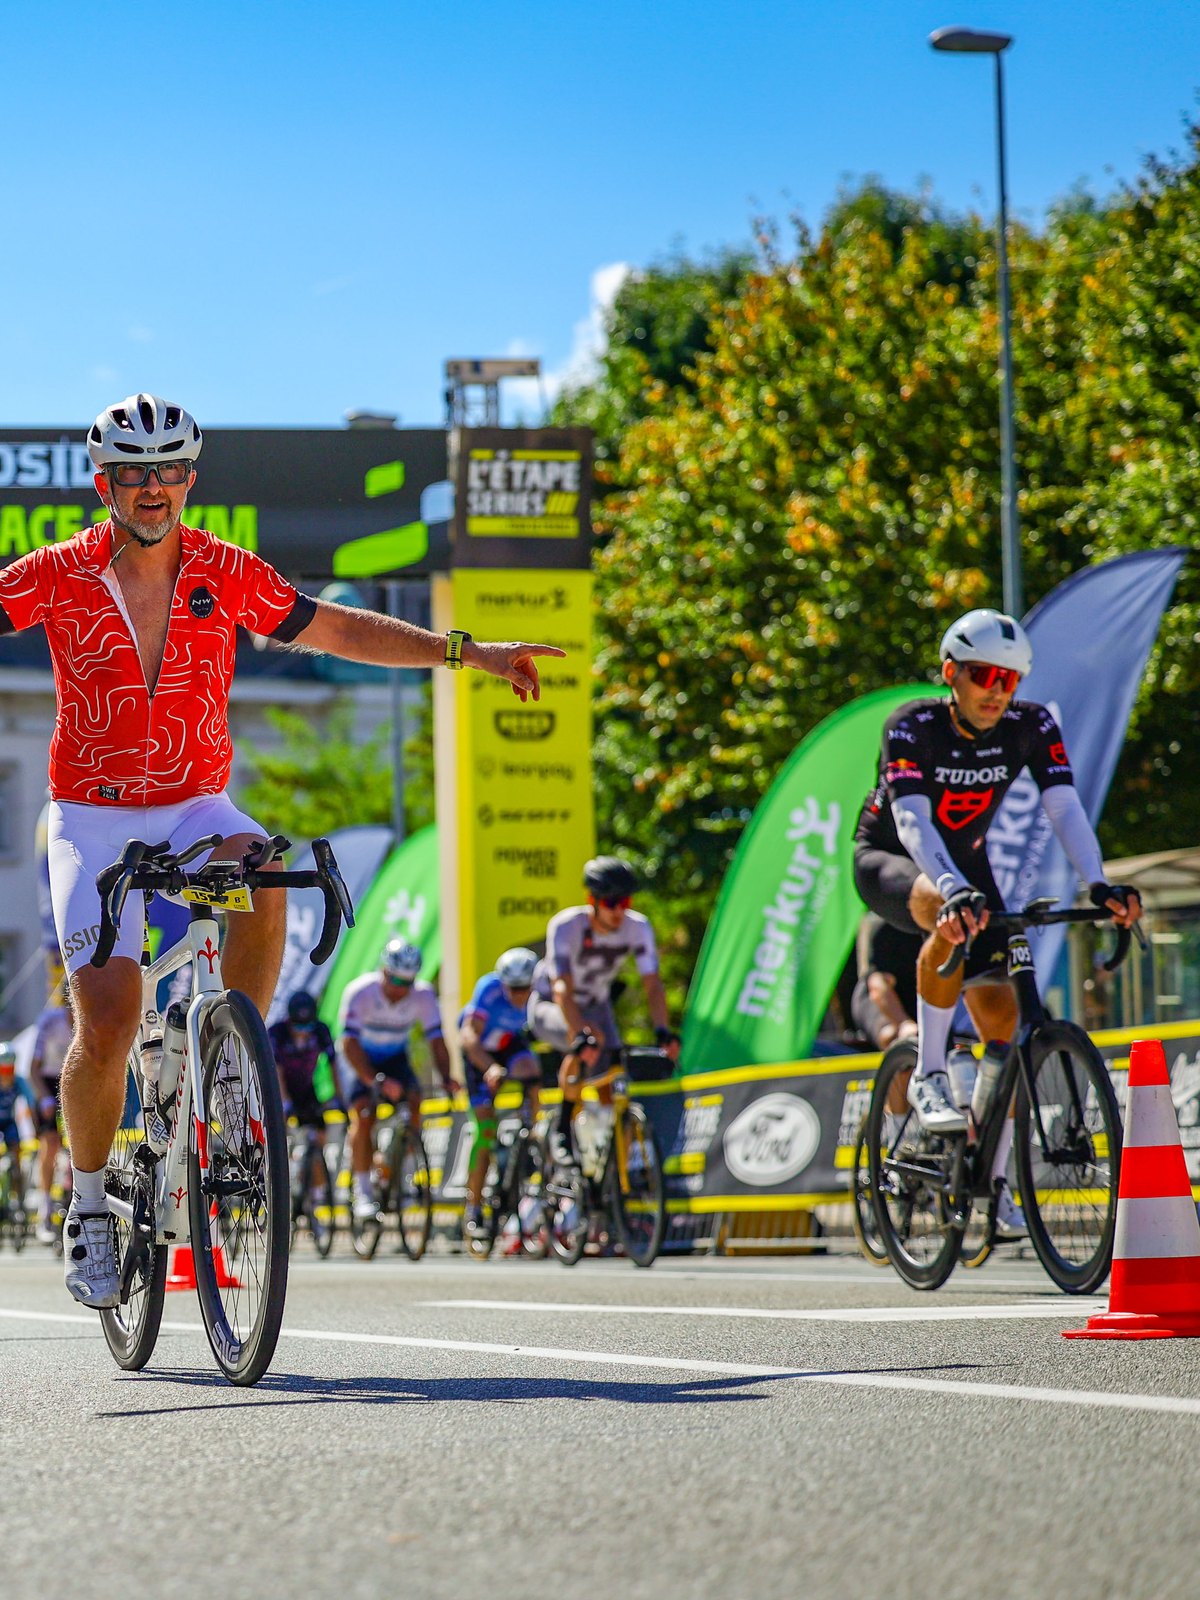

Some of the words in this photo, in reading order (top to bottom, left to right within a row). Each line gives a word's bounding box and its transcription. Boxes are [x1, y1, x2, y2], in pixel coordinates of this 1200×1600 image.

[468, 450, 581, 491] L'ÉTAPE
[934, 765, 1009, 786] TUDOR
[985, 766, 1042, 901] erku
[62, 924, 101, 959] SSIO
[737, 843, 821, 1017] merkur
[745, 1109, 799, 1164] Ford
